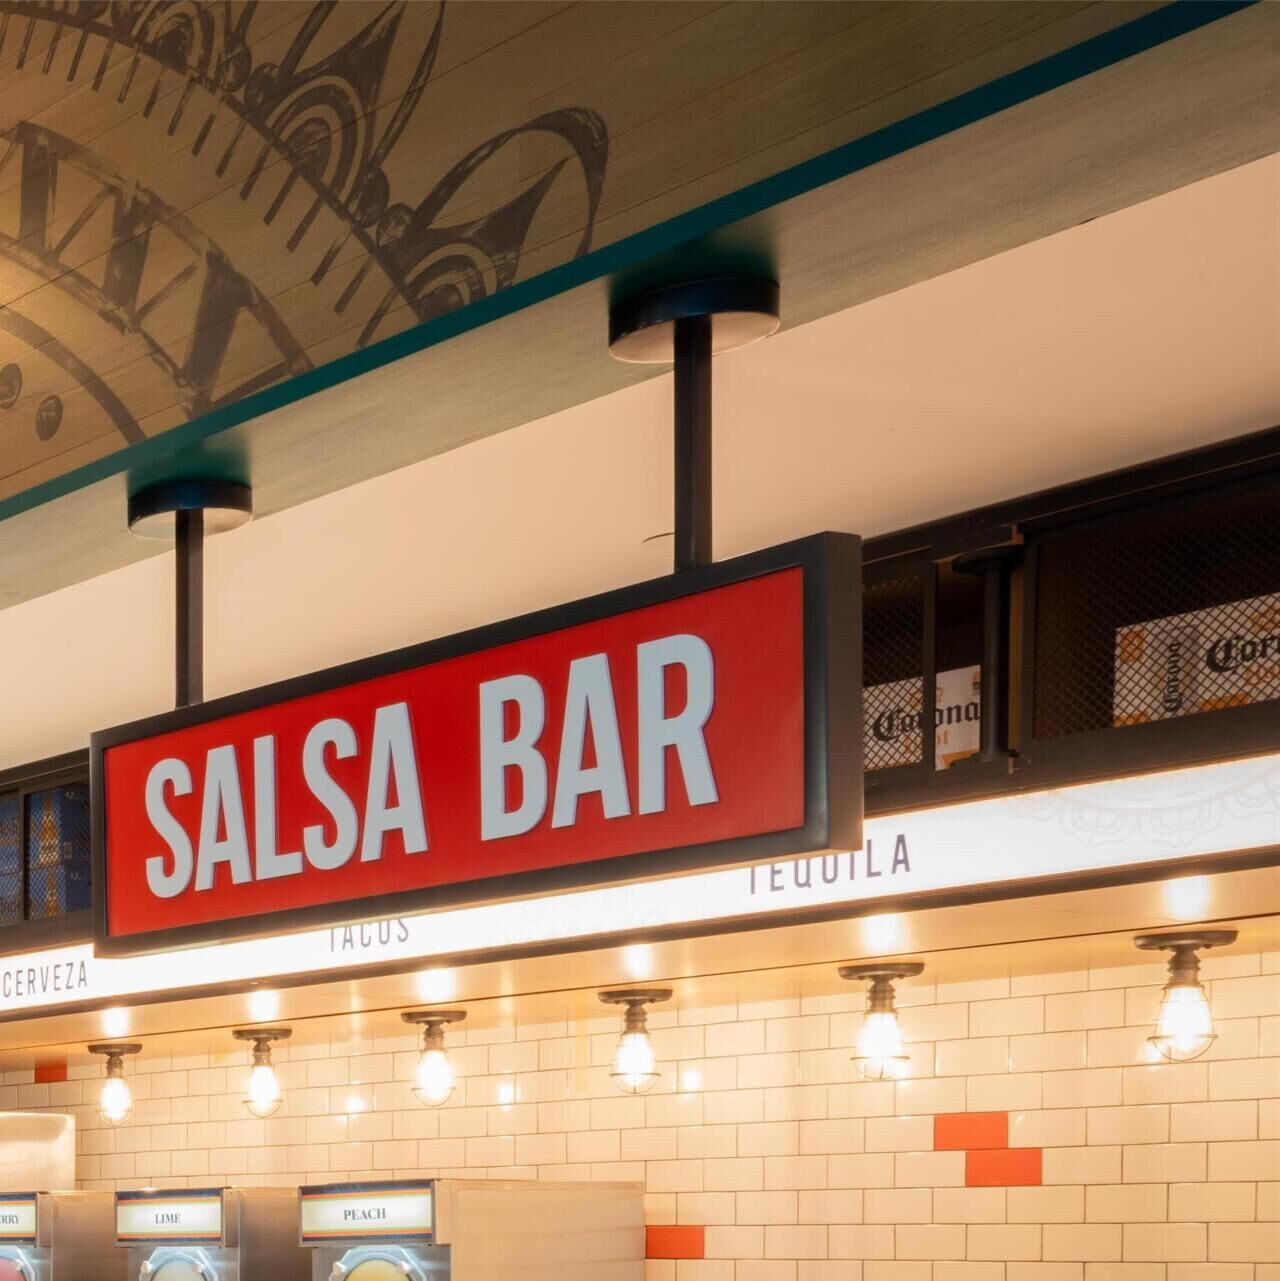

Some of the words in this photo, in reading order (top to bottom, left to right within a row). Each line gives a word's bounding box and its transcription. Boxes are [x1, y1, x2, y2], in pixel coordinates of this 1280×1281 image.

[144, 701, 429, 899] SALSA
[478, 633, 719, 842] BAR
[749, 834, 911, 895] TEQUILA
[328, 918, 412, 954] TACOS
[2, 960, 89, 998] CERVEZA
[154, 1212, 181, 1225] LIME
[343, 1206, 387, 1222] PEACH
